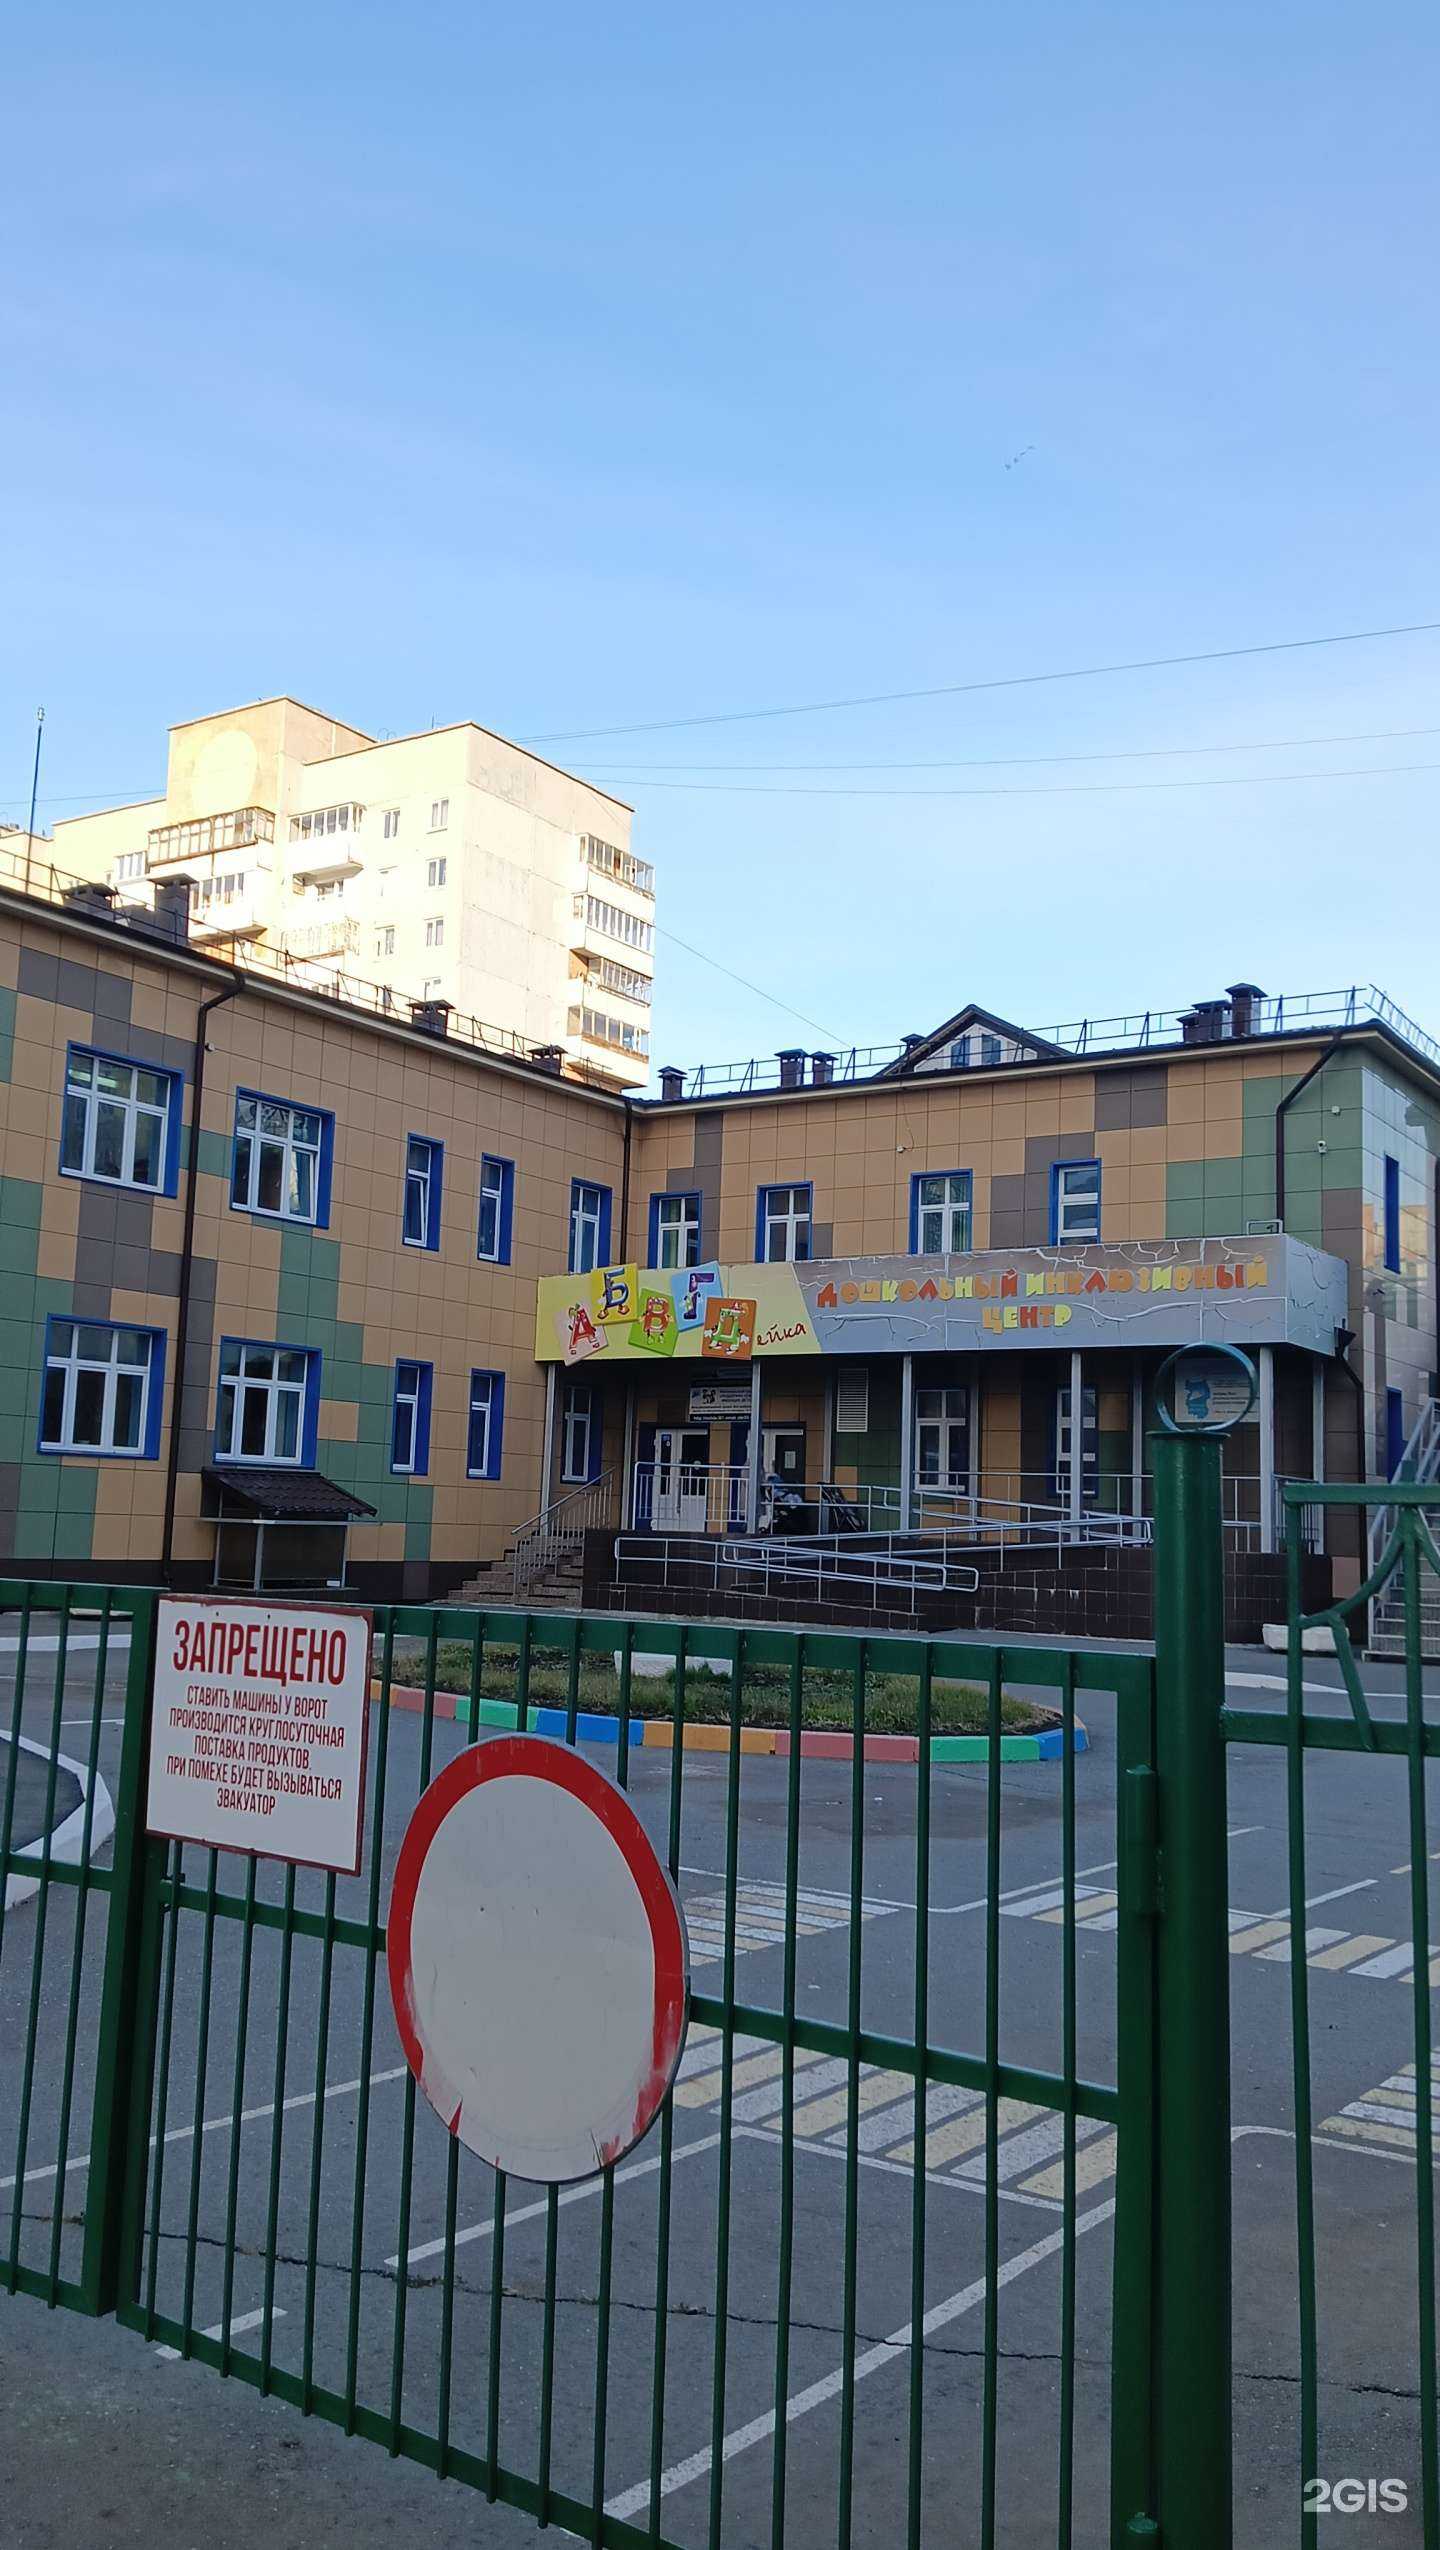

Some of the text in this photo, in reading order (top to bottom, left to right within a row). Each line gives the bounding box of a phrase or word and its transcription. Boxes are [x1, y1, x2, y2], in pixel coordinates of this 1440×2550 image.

[816, 1253, 1268, 1308] ДОШКОЛЬНЫЙ ИНКЛЮЗИВНЫЙ
[982, 1303, 1073, 1335] ЦЕНТР
[172, 1619, 347, 1687] ЗАПРЕЩЕНО
[187, 1685, 328, 1719] СТАВИТЬ МАШИНЫ У ВОРОТ
[169, 1707, 345, 1748] ПРОИЗВОДИТСЯ КРУГЛОСУТОЧНАЯ
[194, 1734, 312, 1771] ПОСТАВКА ПРОДУКТОВ.
[166, 1755, 342, 1800] ПРИ ПОМЕХЕ БУДЕТ ВЫЗЫВАТЬСЯ
[217, 1787, 276, 1815] ЭВАКУАТОР
